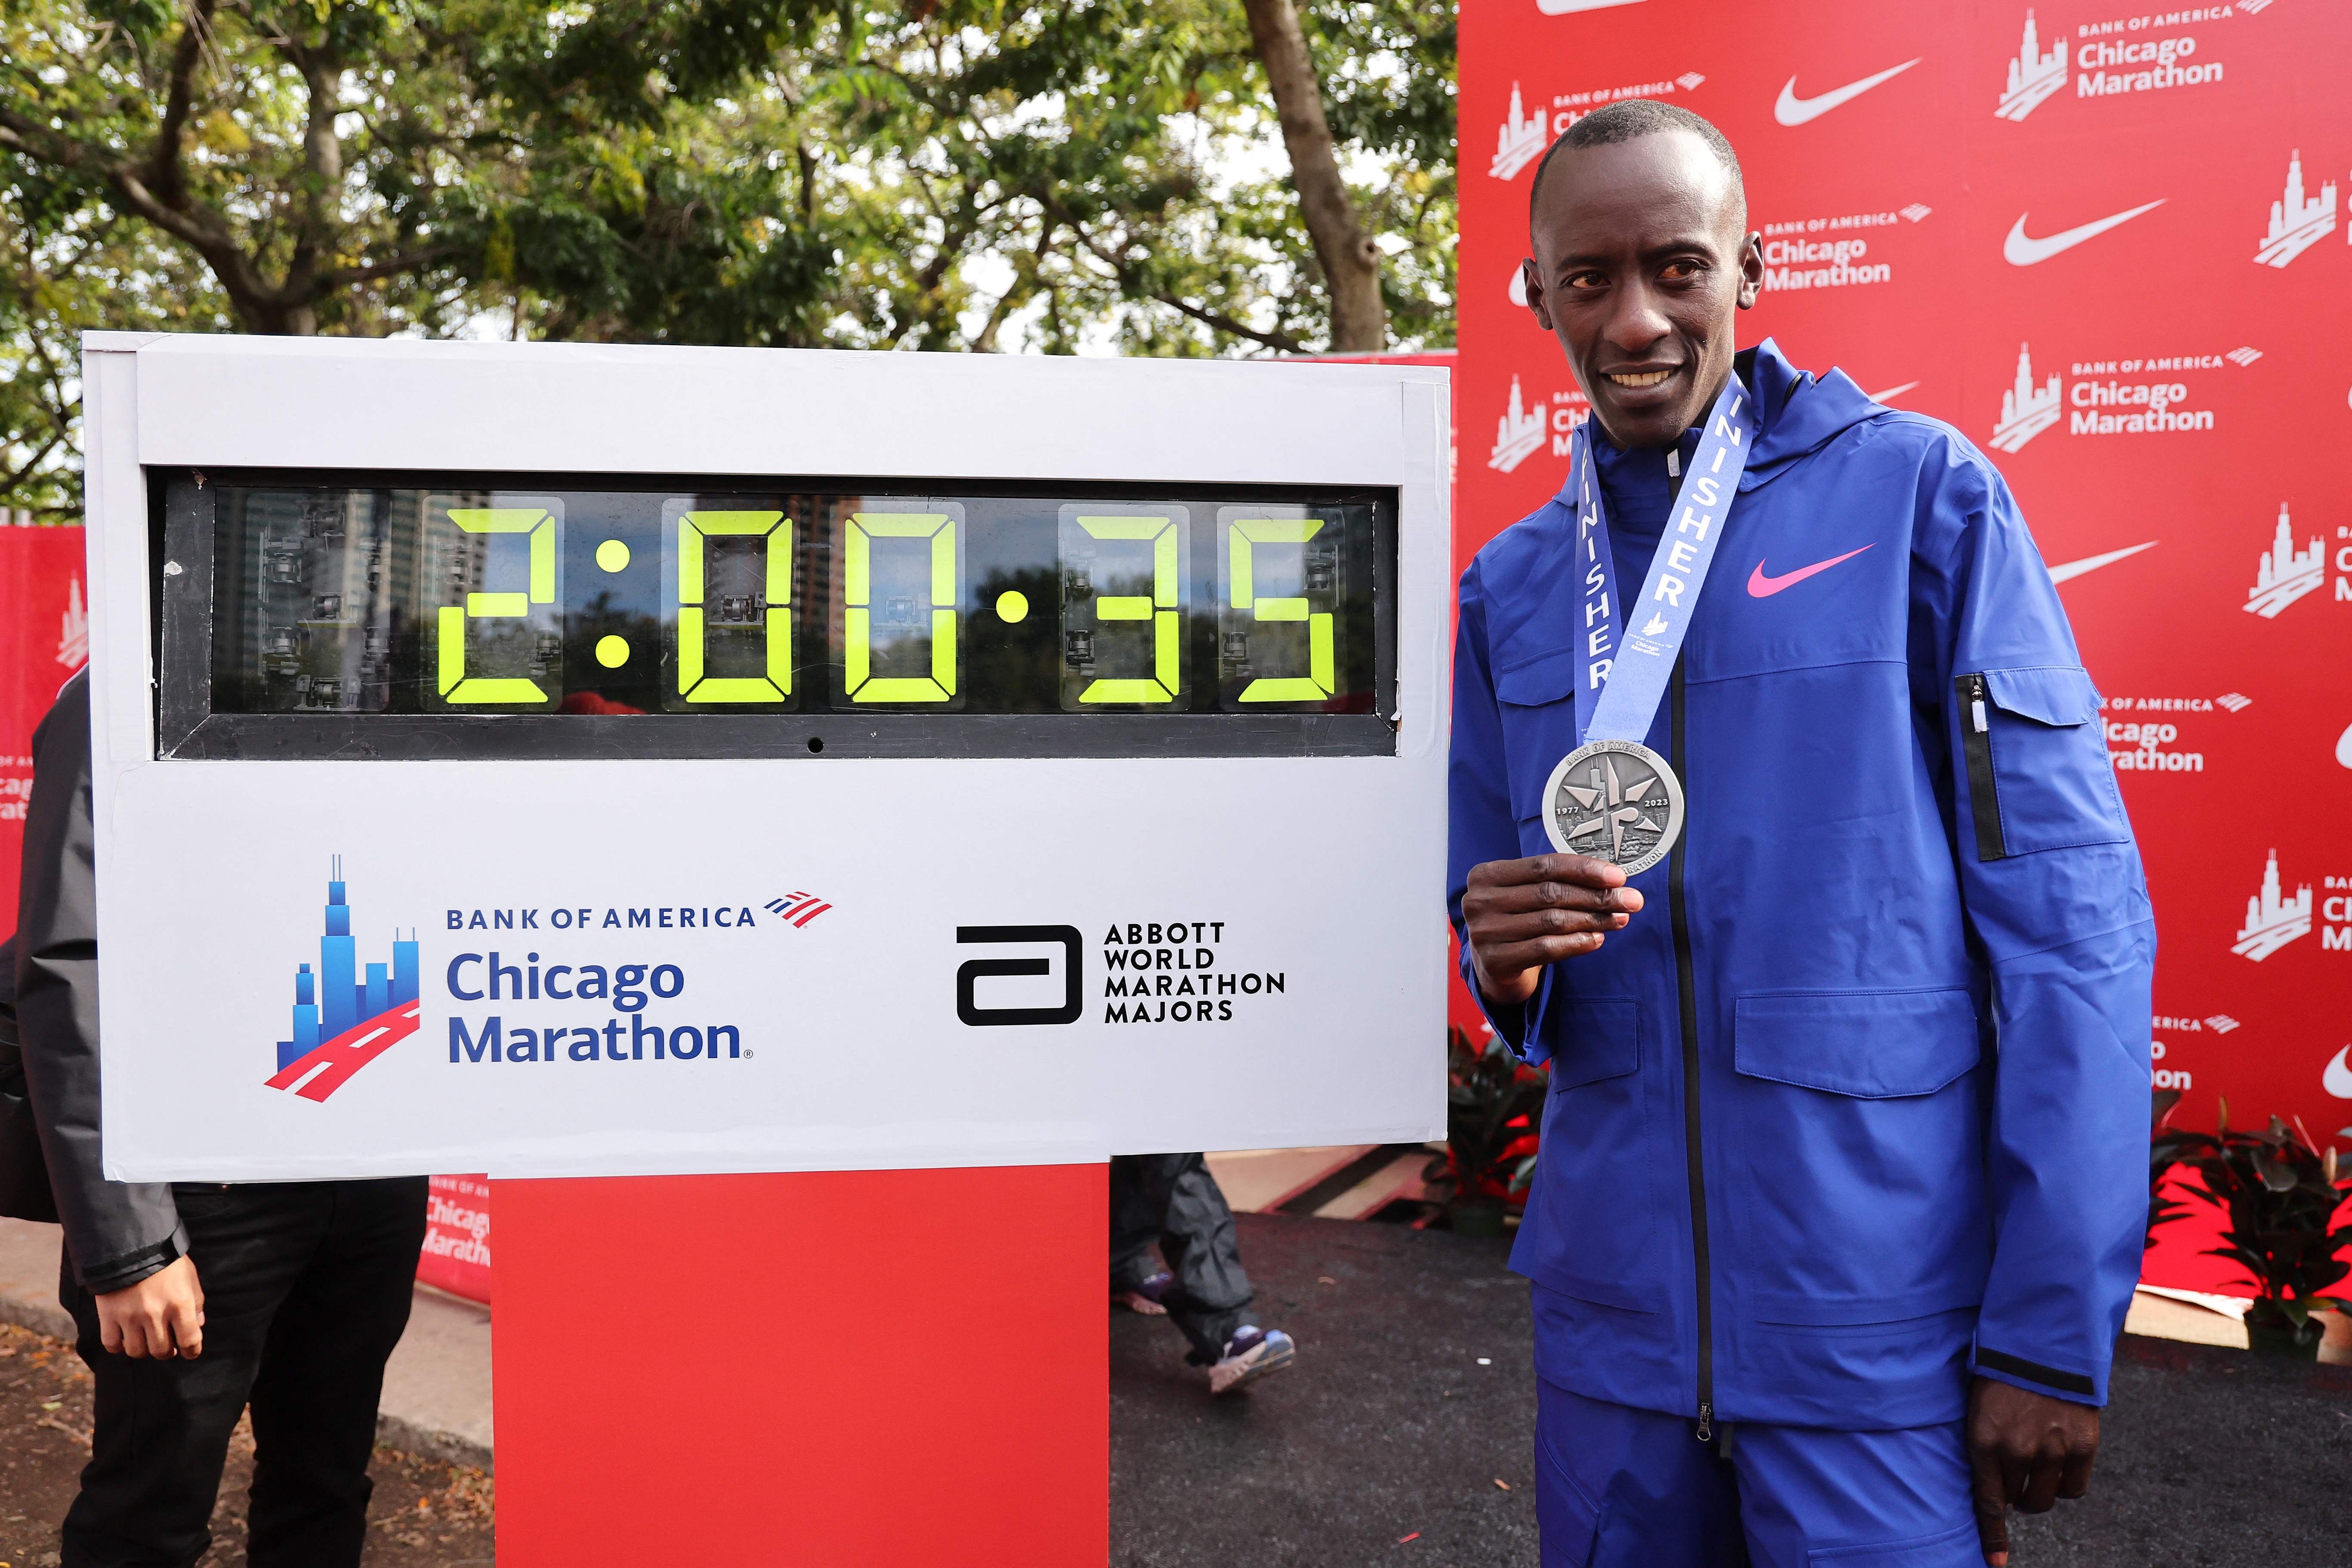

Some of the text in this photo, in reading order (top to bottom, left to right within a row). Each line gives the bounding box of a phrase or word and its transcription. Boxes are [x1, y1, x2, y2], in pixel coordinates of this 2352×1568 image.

[2079, 5, 2233, 38] BANK OF AMERICA
[2077, 36, 2196, 69] Chicago
[2077, 61, 2224, 98] Marathon
[1553, 81, 1675, 108] BANK OF AMERICA
[1764, 212, 1899, 236] BANK OF AMERICA
[1764, 238, 1867, 265] Chicago
[1764, 263, 1891, 292] Marathon
[2071, 355, 2224, 376] BANK OF AMERICA
[2070, 380, 2187, 409] Chicago
[2070, 408, 2214, 435] Marathon
[1631, 644, 1660, 657] Marathon
[1635, 641, 1659, 652] Chicago
[2111, 697, 2134, 711] OF
[2135, 698, 2214, 711] AMERICA
[1565, 742, 1651, 766] BANK OF AMERICA
[1556, 806, 1579, 815] 1977
[1644, 798, 1669, 807] 2023
[446, 907, 756, 930] BANK OF AMERICA
[1104, 922, 1225, 945] ABBOTT
[1104, 948, 1214, 971] WORLD
[446, 952, 684, 1012] Chicago
[1104, 972, 1285, 998] MARATHON
[1104, 999, 1233, 1024] MAJORS
